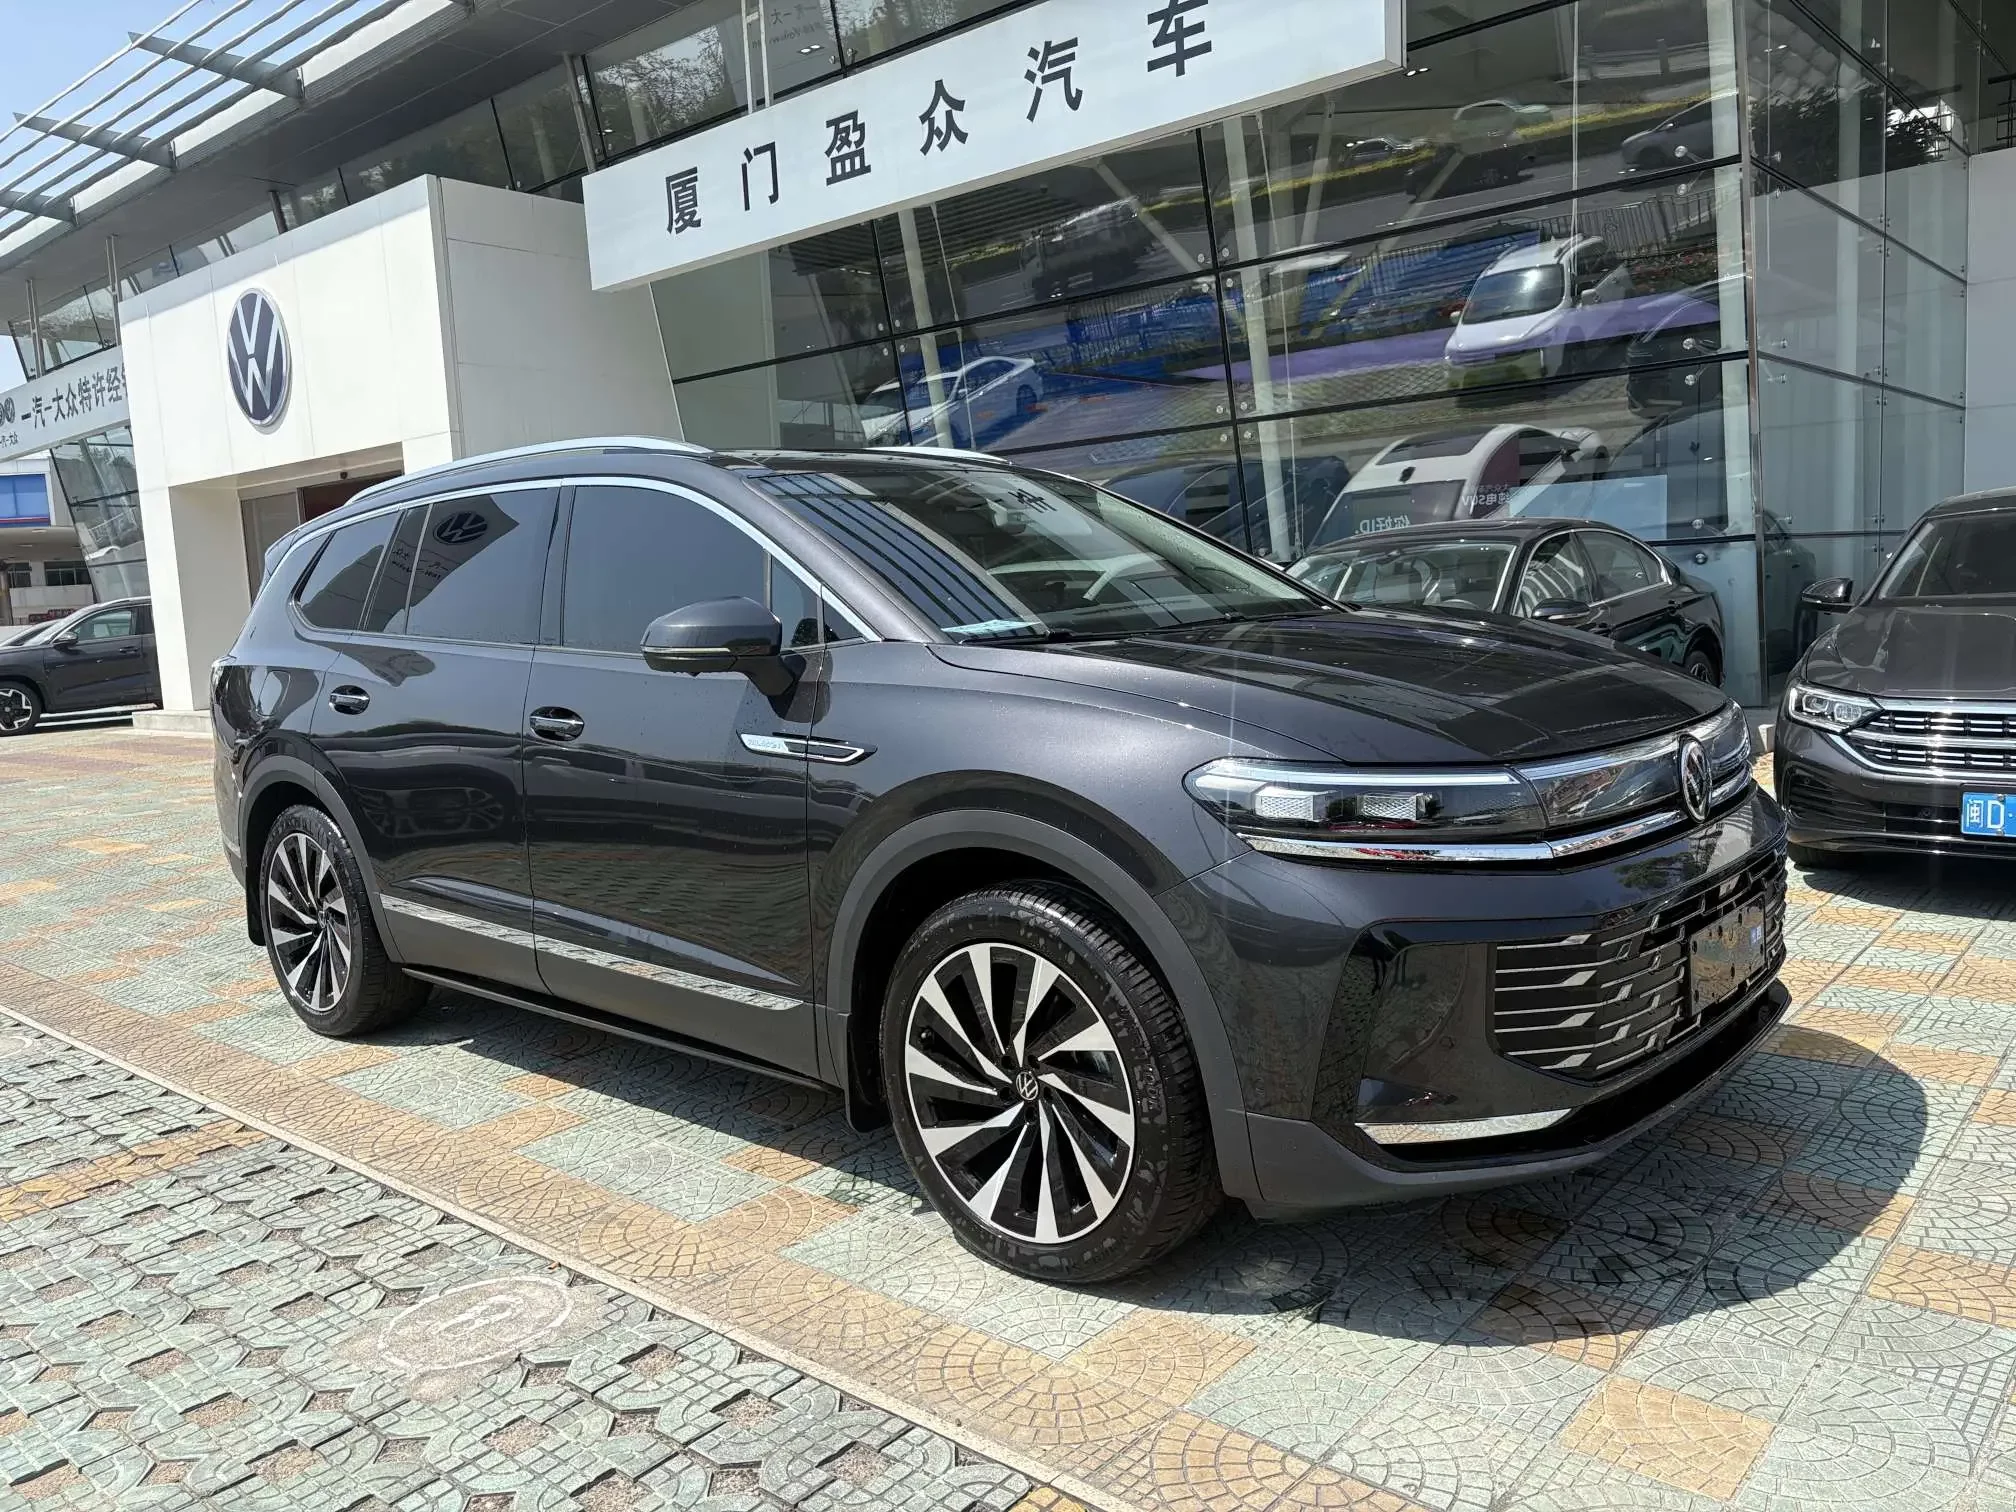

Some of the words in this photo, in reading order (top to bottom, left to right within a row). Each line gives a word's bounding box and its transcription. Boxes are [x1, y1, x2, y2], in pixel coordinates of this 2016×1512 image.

[665, 0, 1212, 235] 厦门盈众汽车
